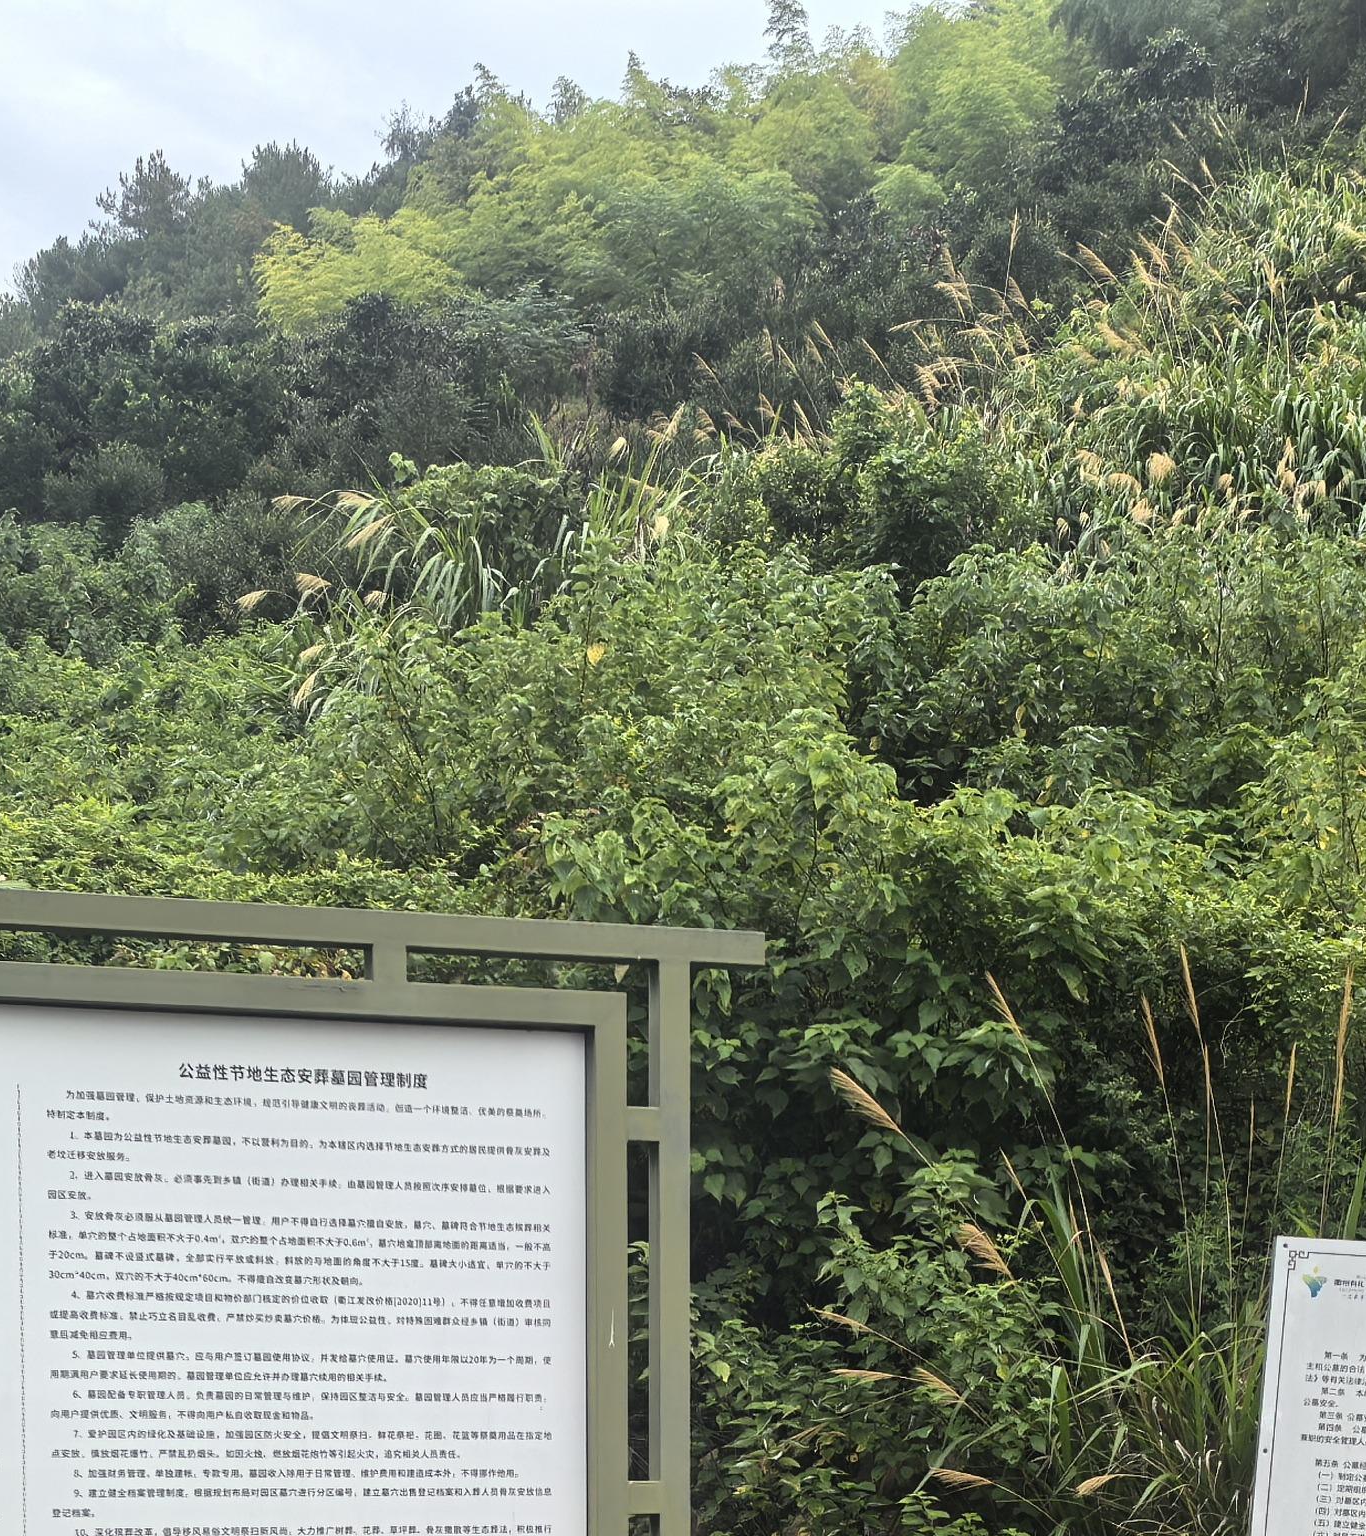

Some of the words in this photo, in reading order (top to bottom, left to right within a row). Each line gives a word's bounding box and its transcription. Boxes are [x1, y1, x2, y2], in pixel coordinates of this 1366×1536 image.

[178, 1061, 427, 1090] 公益性节地生态安葬墓园管理制度
